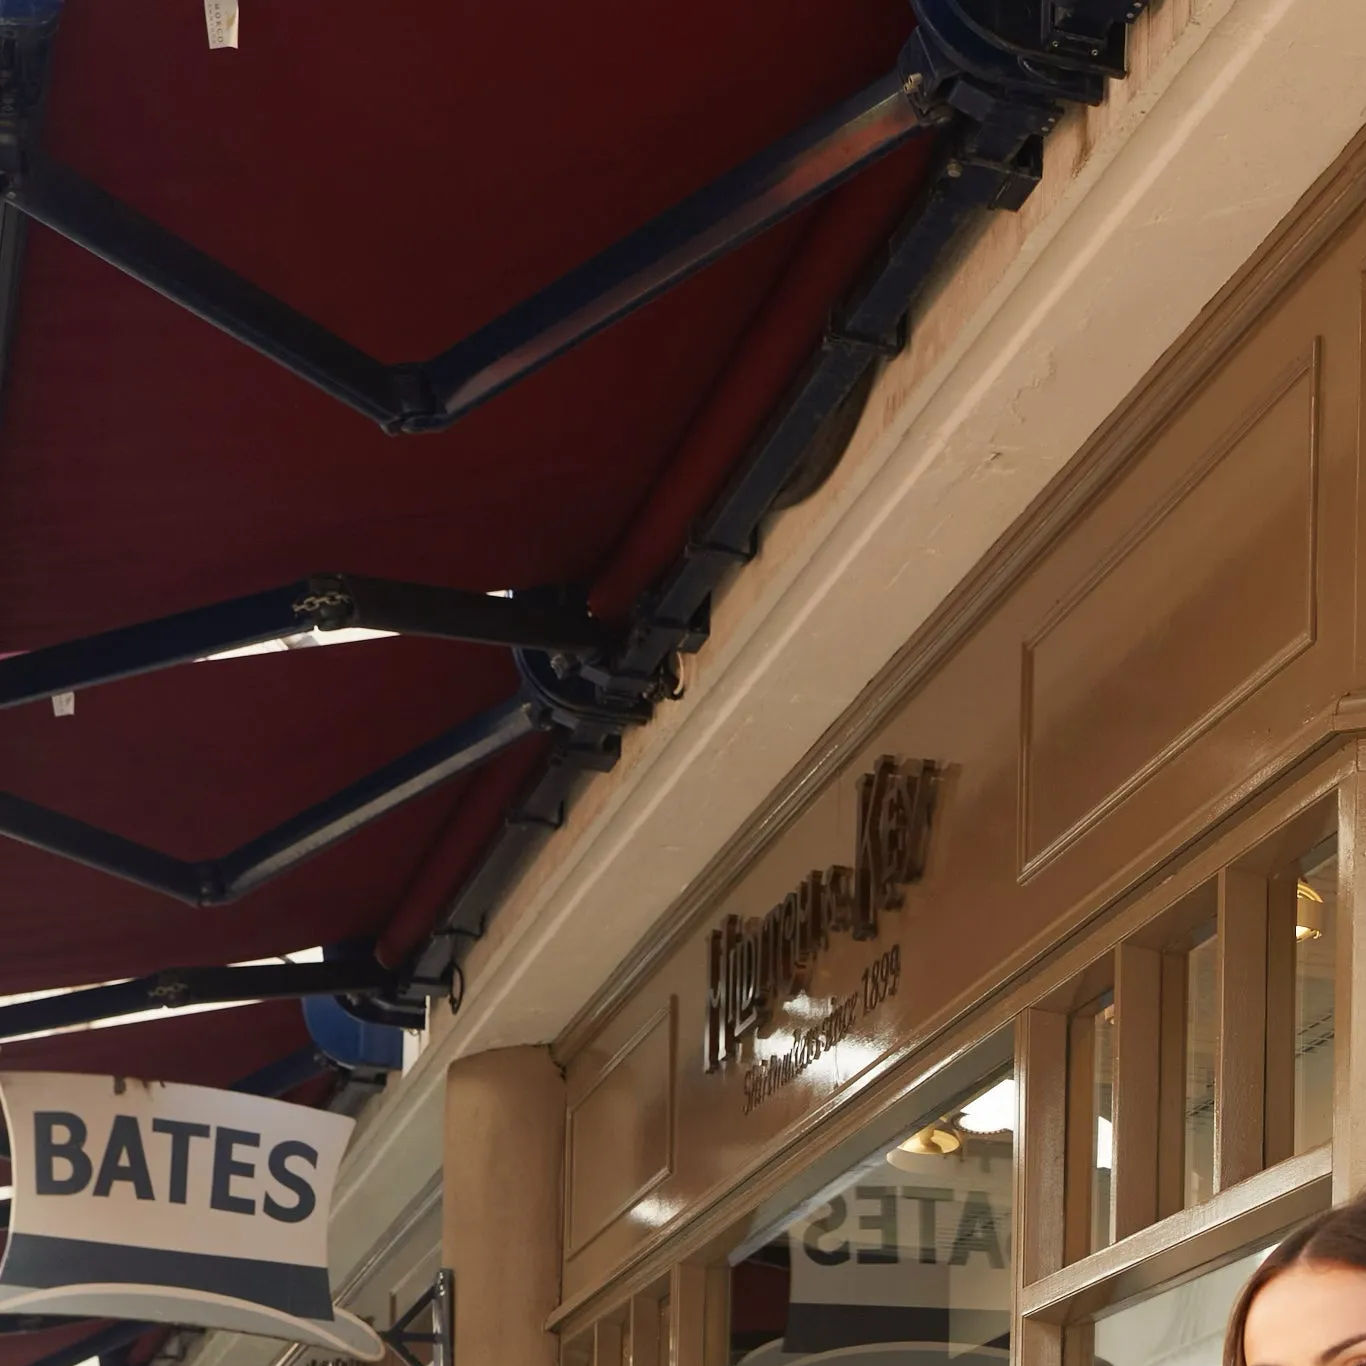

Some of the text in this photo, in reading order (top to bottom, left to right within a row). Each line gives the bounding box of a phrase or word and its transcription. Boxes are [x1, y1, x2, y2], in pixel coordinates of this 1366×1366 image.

[852, 754, 938, 940] KEY
[822, 993, 859, 1052] since
[862, 944, 900, 1017] 1899
[33, 1111, 318, 1223] BATES
